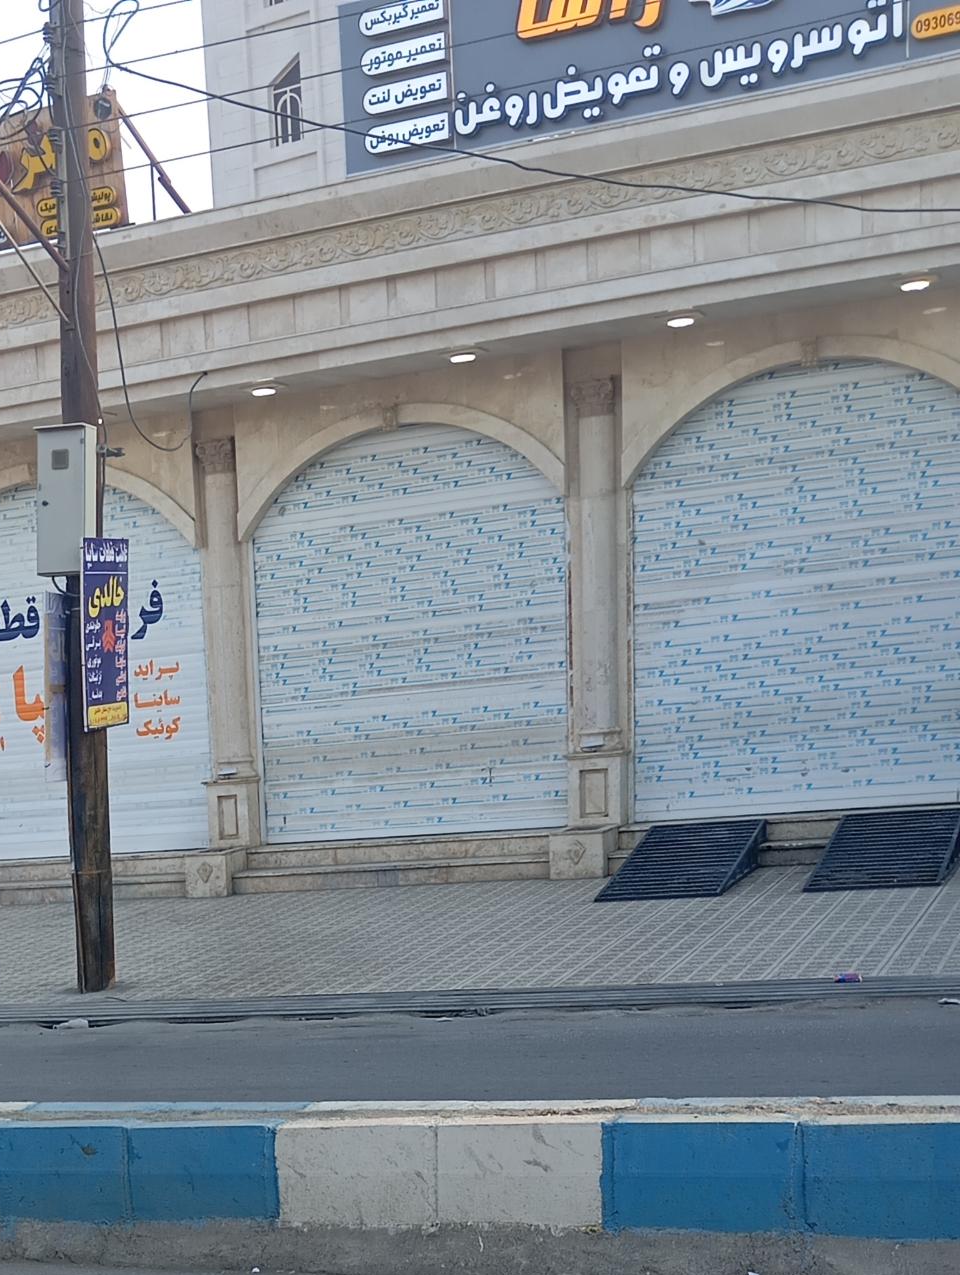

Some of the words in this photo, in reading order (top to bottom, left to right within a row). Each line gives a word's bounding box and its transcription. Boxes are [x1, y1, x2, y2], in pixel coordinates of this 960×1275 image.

[365, 4, 409, 30] گیربکس
[368, 50, 403, 71] موتور
[406, 38, 442, 62] تعمیر
[543, 44, 662, 118] تعویض
[669, 62, 690, 95] و
[368, 89, 390, 106] لنت
[395, 79, 442, 104] تعویض
[455, 82, 538, 134] روغن
[402, 119, 445, 142] تعویض
[88, 575, 125, 618] خالدی
[134, 659, 180, 681] پراید
[134, 692, 181, 712] ساینا
